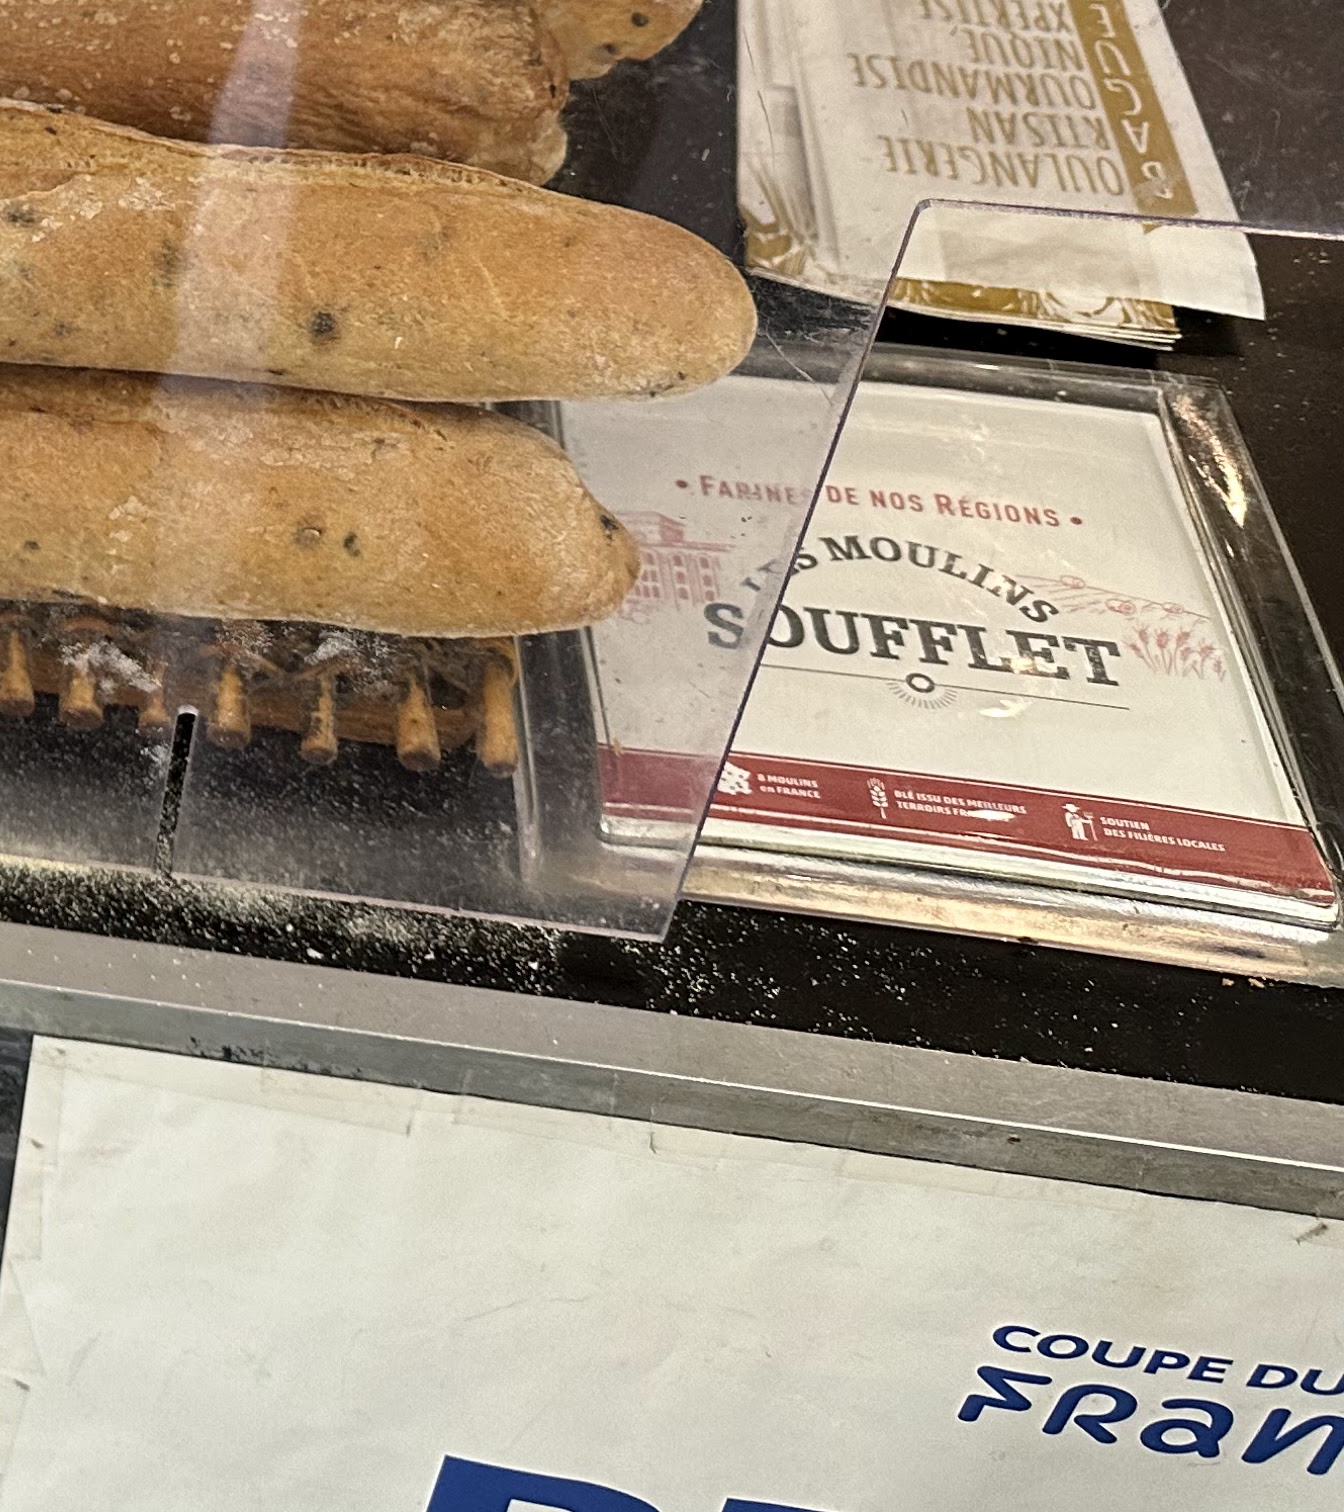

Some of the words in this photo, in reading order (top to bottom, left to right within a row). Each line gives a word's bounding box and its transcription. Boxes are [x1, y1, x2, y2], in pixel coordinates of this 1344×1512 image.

[825, 484, 861, 506] DE
[869, 488, 923, 514] NOS
[933, 492, 1061, 529] RÉGIONS
[818, 535, 1060, 624] MOULINS
[703, 602, 1121, 687] SOUFFLET
[767, 775, 819, 788] MOULINS
[775, 787, 821, 799] FRANCE
[894, 789, 915, 801] BLÉ
[915, 793, 941, 804] ISSU
[942, 795, 965, 807] DES
[966, 798, 1028, 815] MEILLEURS
[896, 800, 952, 815] TERROIRS
[1099, 816, 1150, 831] SOUTIEN
[1104, 828, 1126, 839] DES
[1127, 831, 1175, 846] FILIÈRES
[1177, 837, 1226, 852] LOCALES
[992, 1324, 1234, 1384] COUPE
[1245, 1363, 1344, 1396] DU
